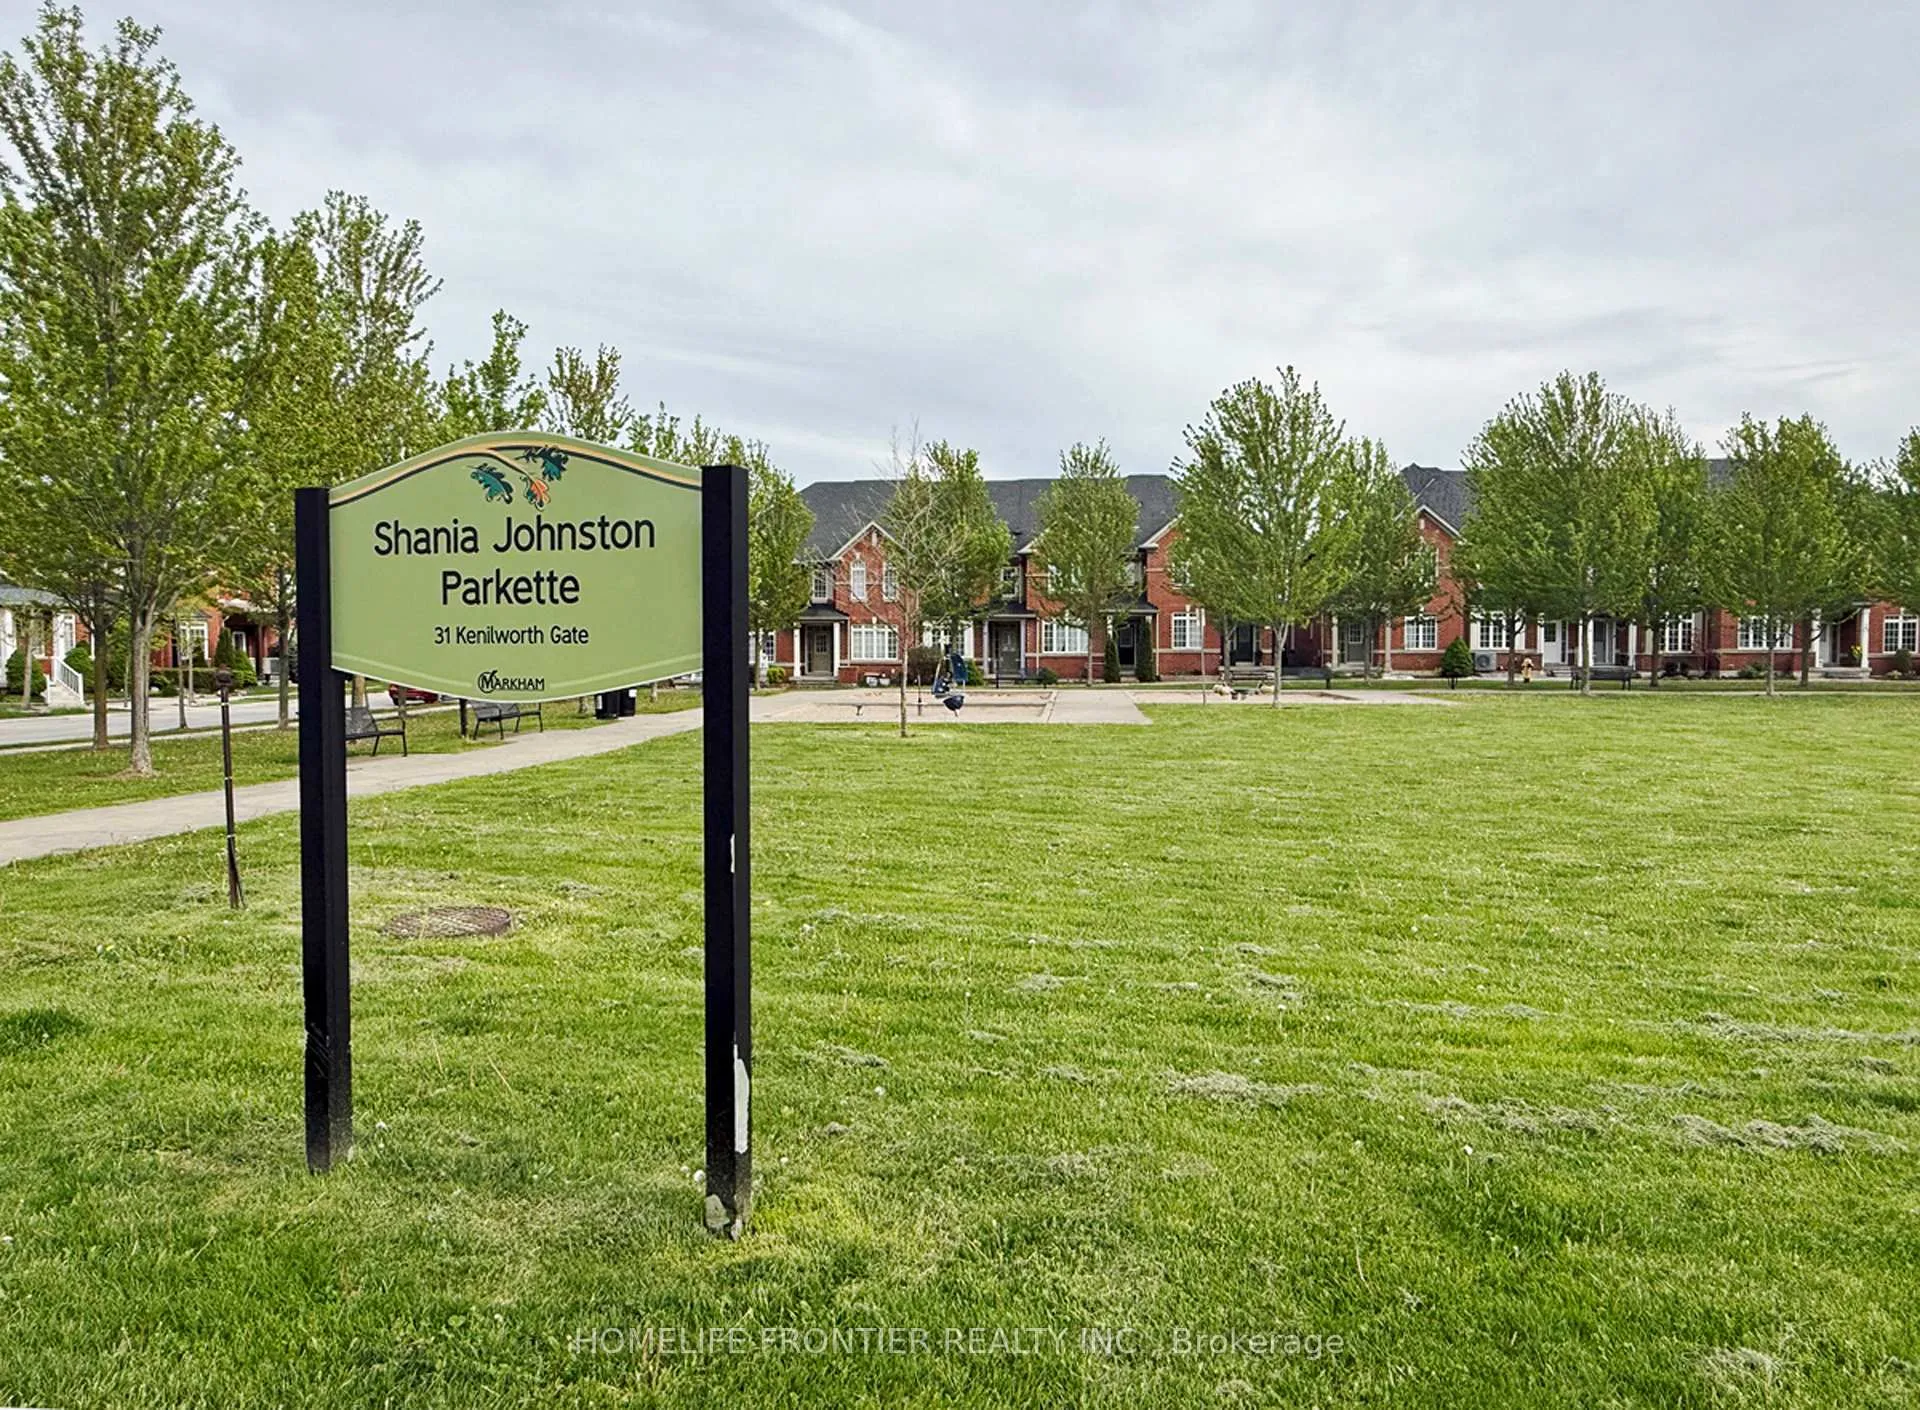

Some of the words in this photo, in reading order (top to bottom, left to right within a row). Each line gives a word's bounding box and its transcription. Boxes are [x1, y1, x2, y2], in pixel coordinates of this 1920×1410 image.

[374, 518, 479, 556] Shania
[493, 514, 655, 553] Johnston
[441, 568, 580, 606] Parkette
[434, 626, 451, 644] 31
[456, 625, 544, 645] Kenilworth
[550, 626, 589, 644] Gate
[478, 670, 545, 694] MARKHAM
